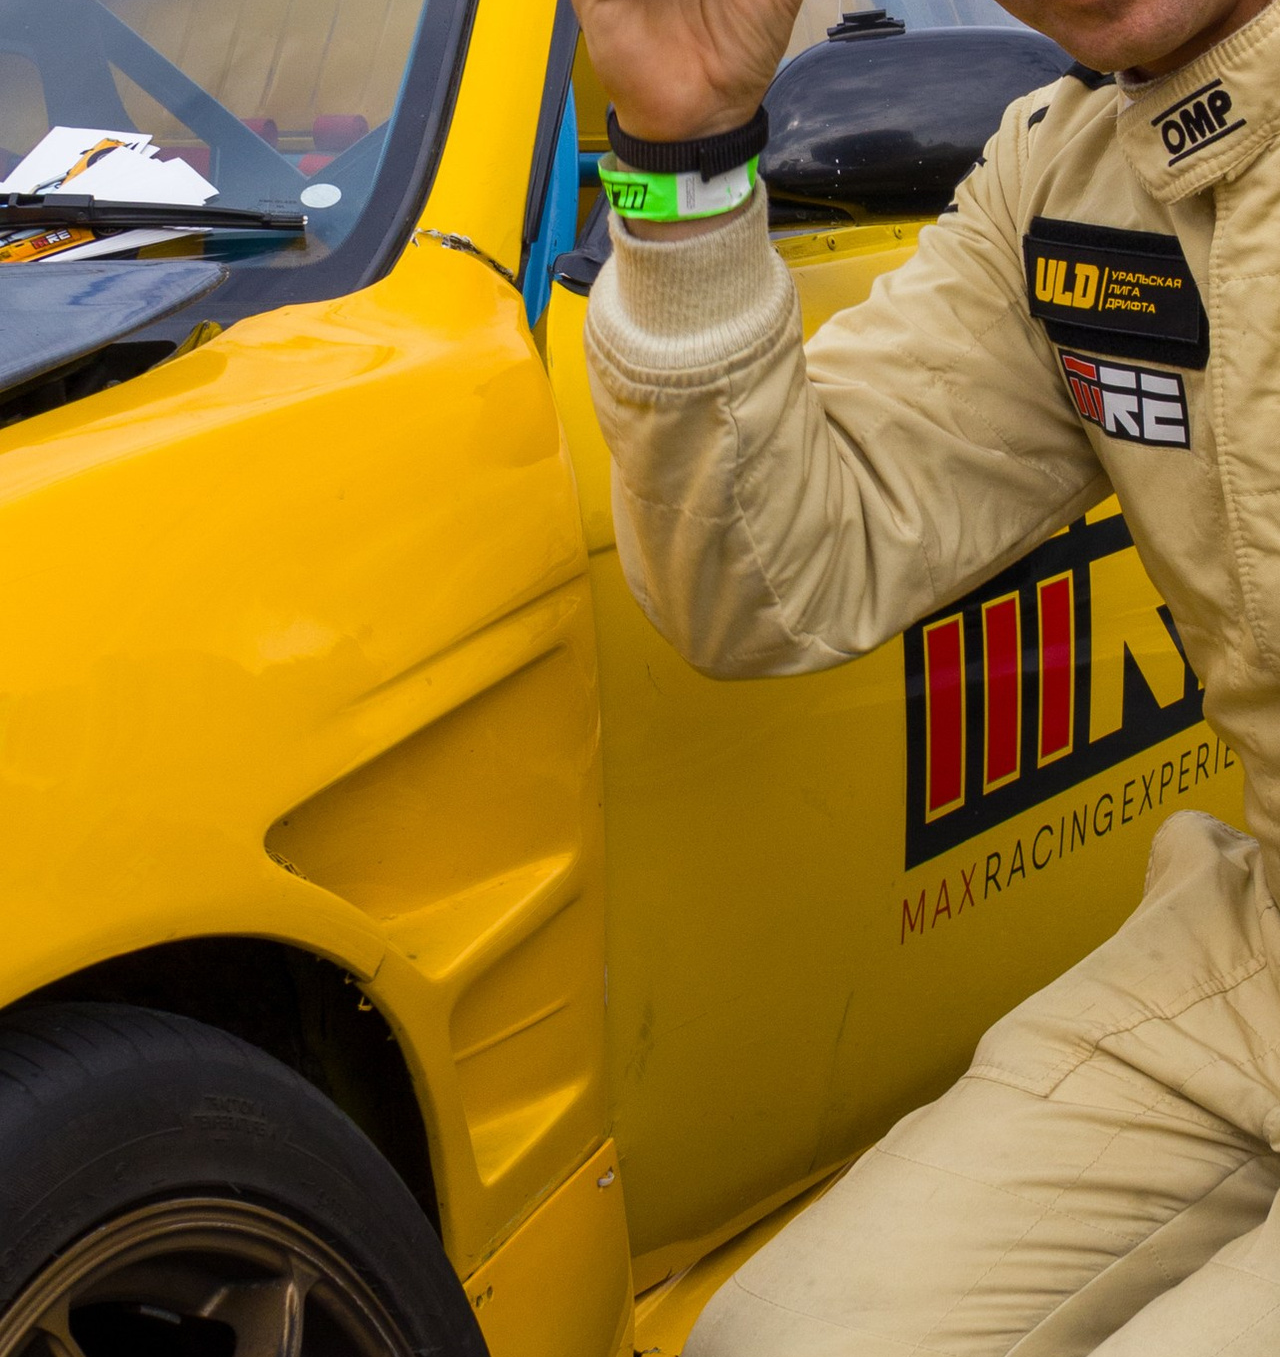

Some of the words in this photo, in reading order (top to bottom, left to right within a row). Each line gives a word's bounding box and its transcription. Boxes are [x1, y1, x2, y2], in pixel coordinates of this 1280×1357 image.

[1161, 89, 1232, 155] OMP
[1035, 257, 1099, 309] ULD
[1108, 284, 1141, 297] ЛИГА
[1111, 270, 1182, 289] УРАЛЬСКАЯ
[1105, 299, 1156, 314] ДРИФТА
[900, 737, 1236, 946] MAXRACINGEXPERIE
